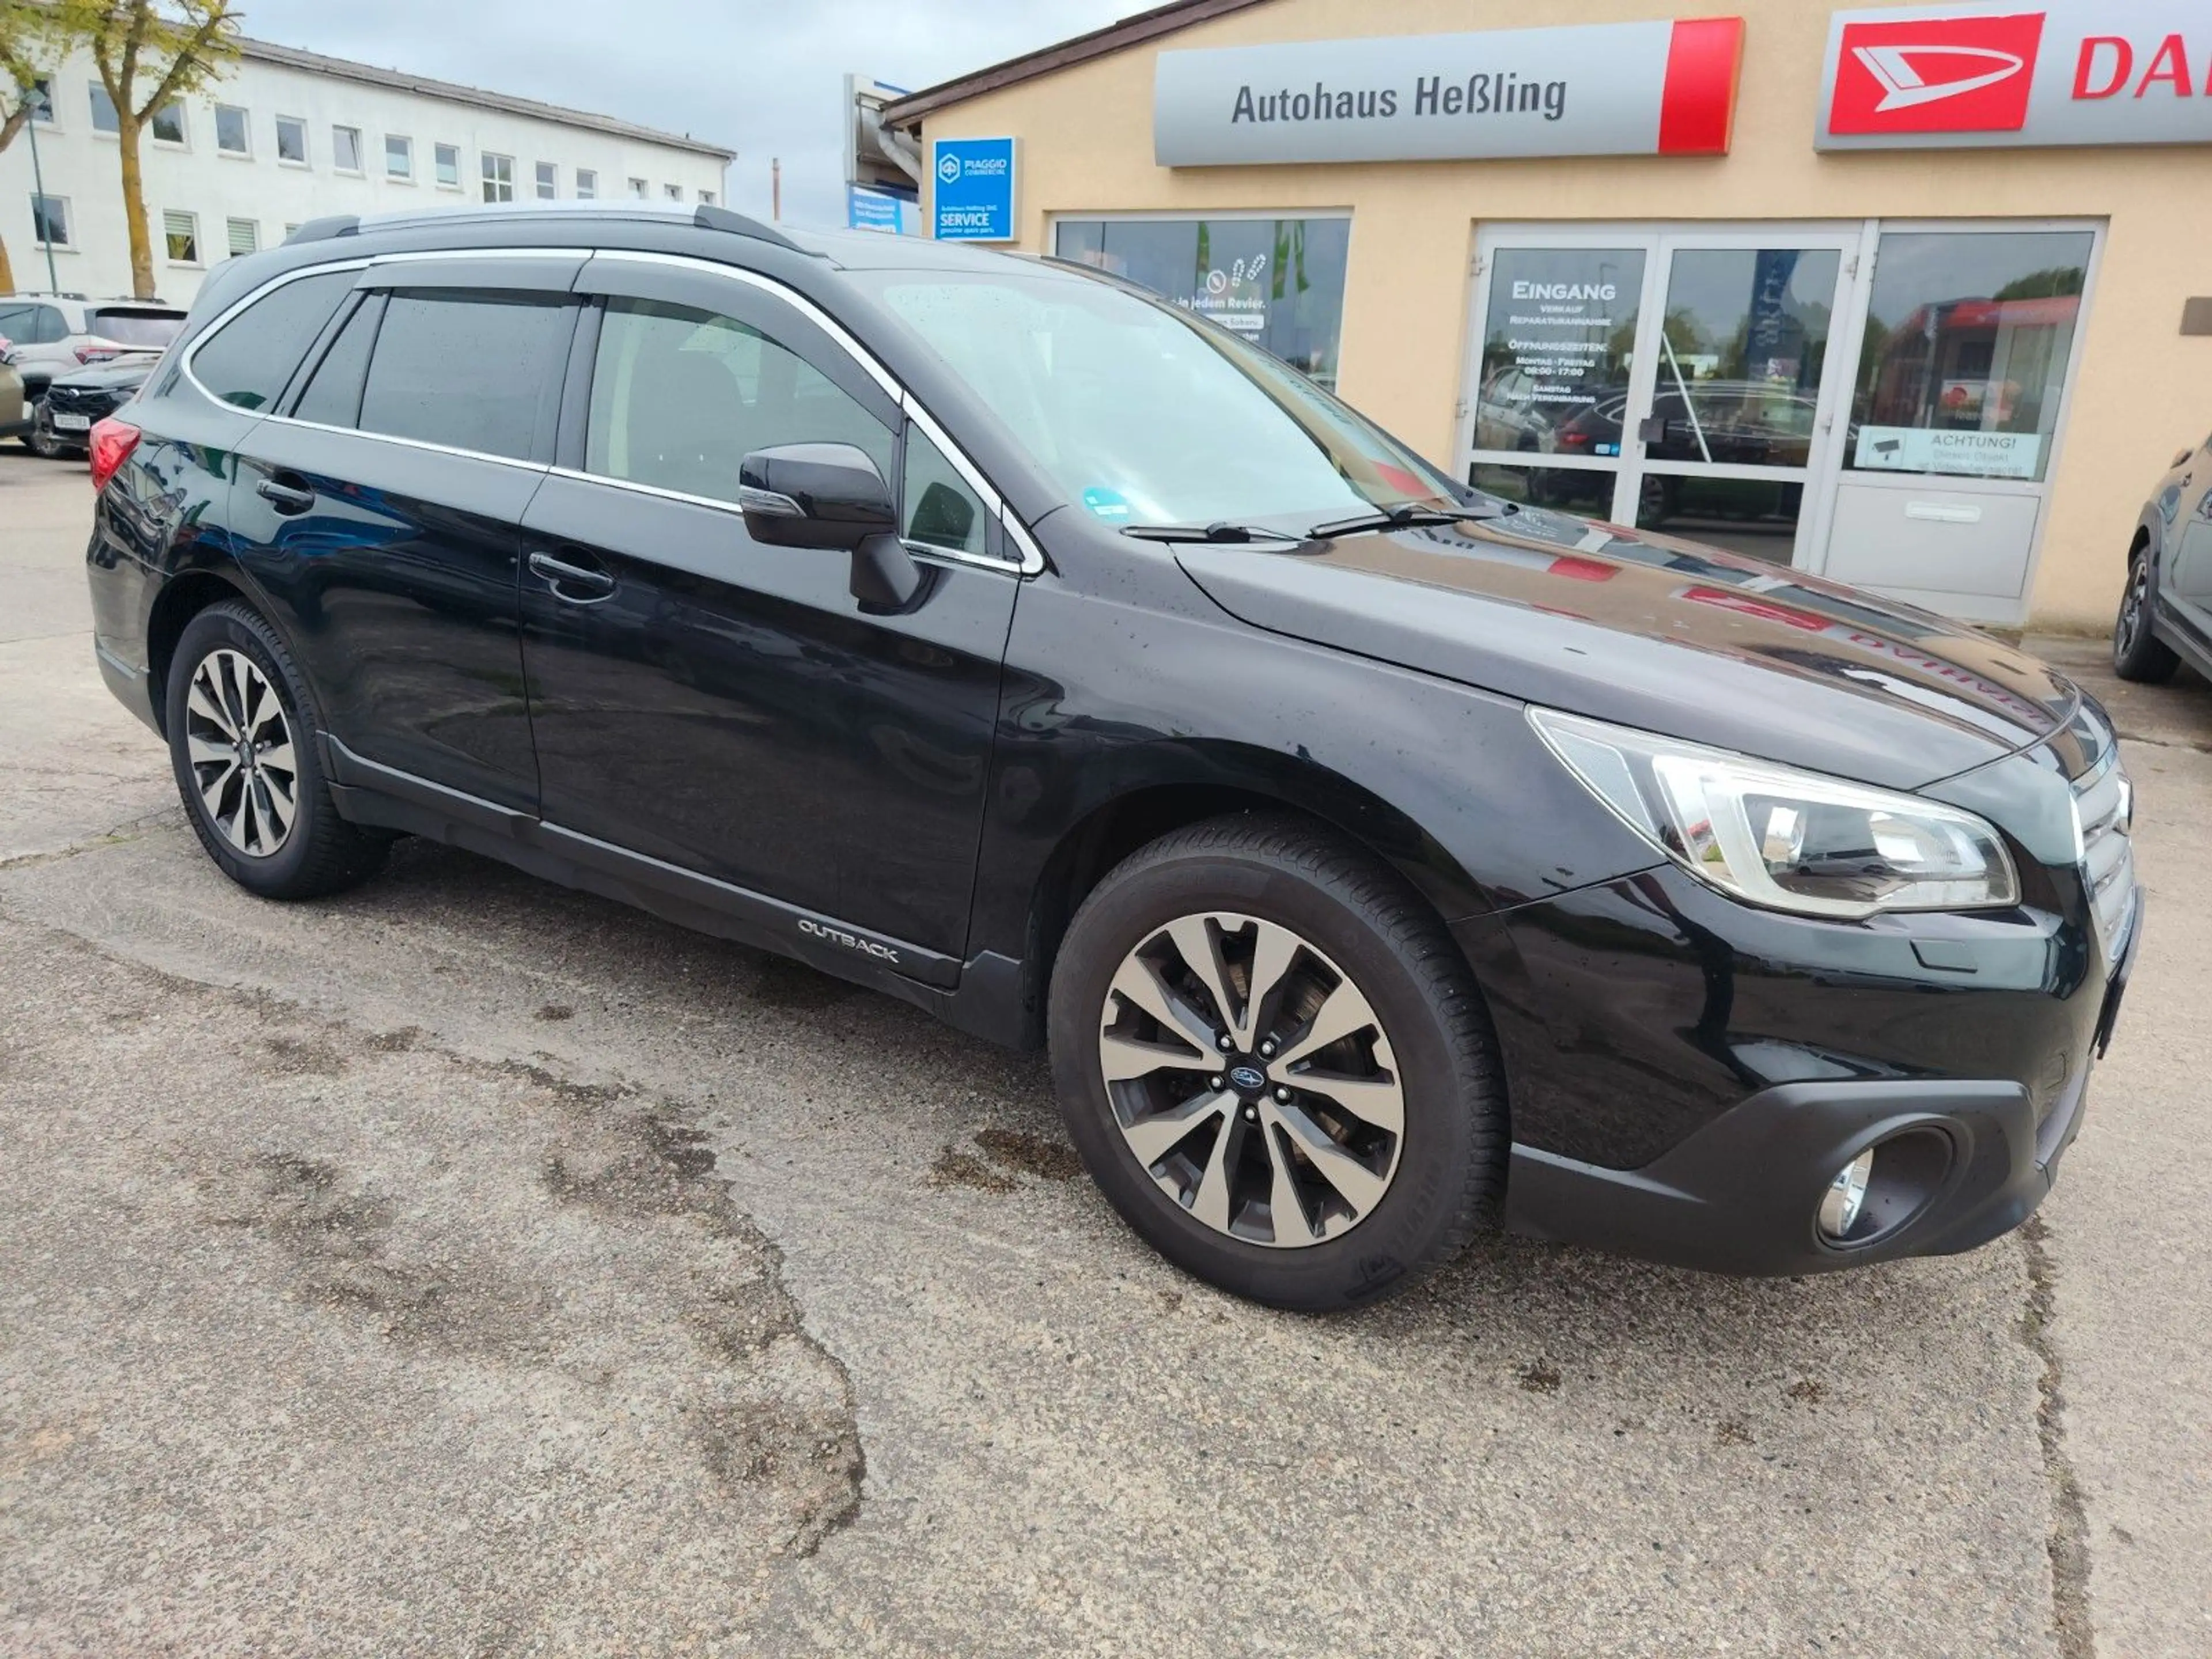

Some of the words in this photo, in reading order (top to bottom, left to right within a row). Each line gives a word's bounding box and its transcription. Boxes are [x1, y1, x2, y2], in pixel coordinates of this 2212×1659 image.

[1232, 82, 1397, 123] Autohaus
[1415, 73, 1566, 120] Heßling
[964, 158, 1007, 169] PIAGGIO
[940, 213, 989, 226] SERVICE
[1512, 280, 1616, 300] EINGANG
[1191, 296, 1225, 310] jedem
[1228, 297, 1266, 309] Revier.
[1558, 367, 1584, 376] 17:00
[1931, 435, 2017, 449] ACHTUNG!
[798, 919, 900, 963] OUTBACK
